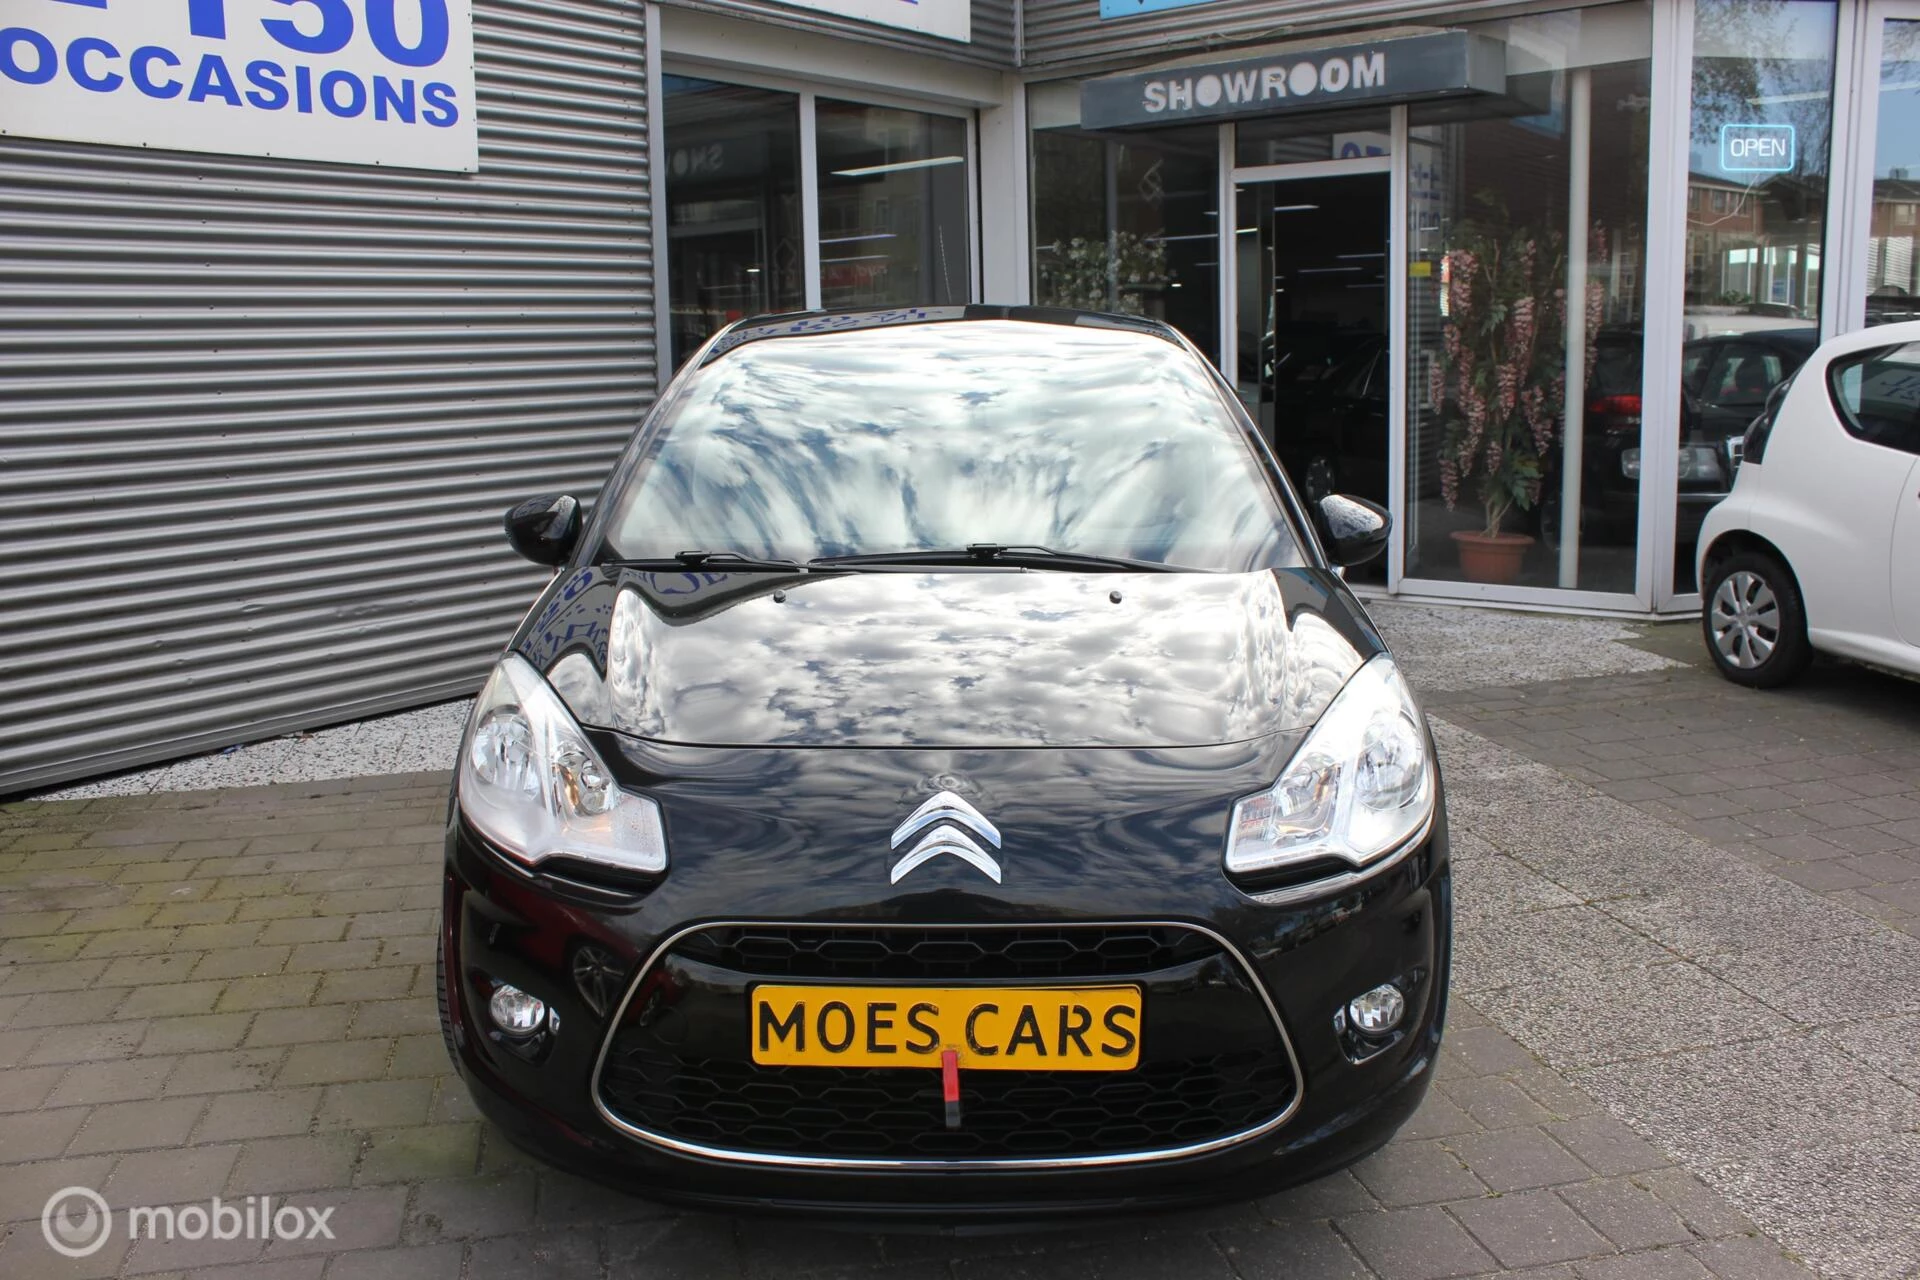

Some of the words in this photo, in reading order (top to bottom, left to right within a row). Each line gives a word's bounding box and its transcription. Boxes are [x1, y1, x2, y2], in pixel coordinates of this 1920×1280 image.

[0, 27, 459, 128] OCCASIONS
[1143, 52, 1385, 113] SHOWROOM
[1730, 137, 1786, 157] OPEN
[759, 1000, 940, 1054] MOES
[965, 1003, 1137, 1058] CARS
